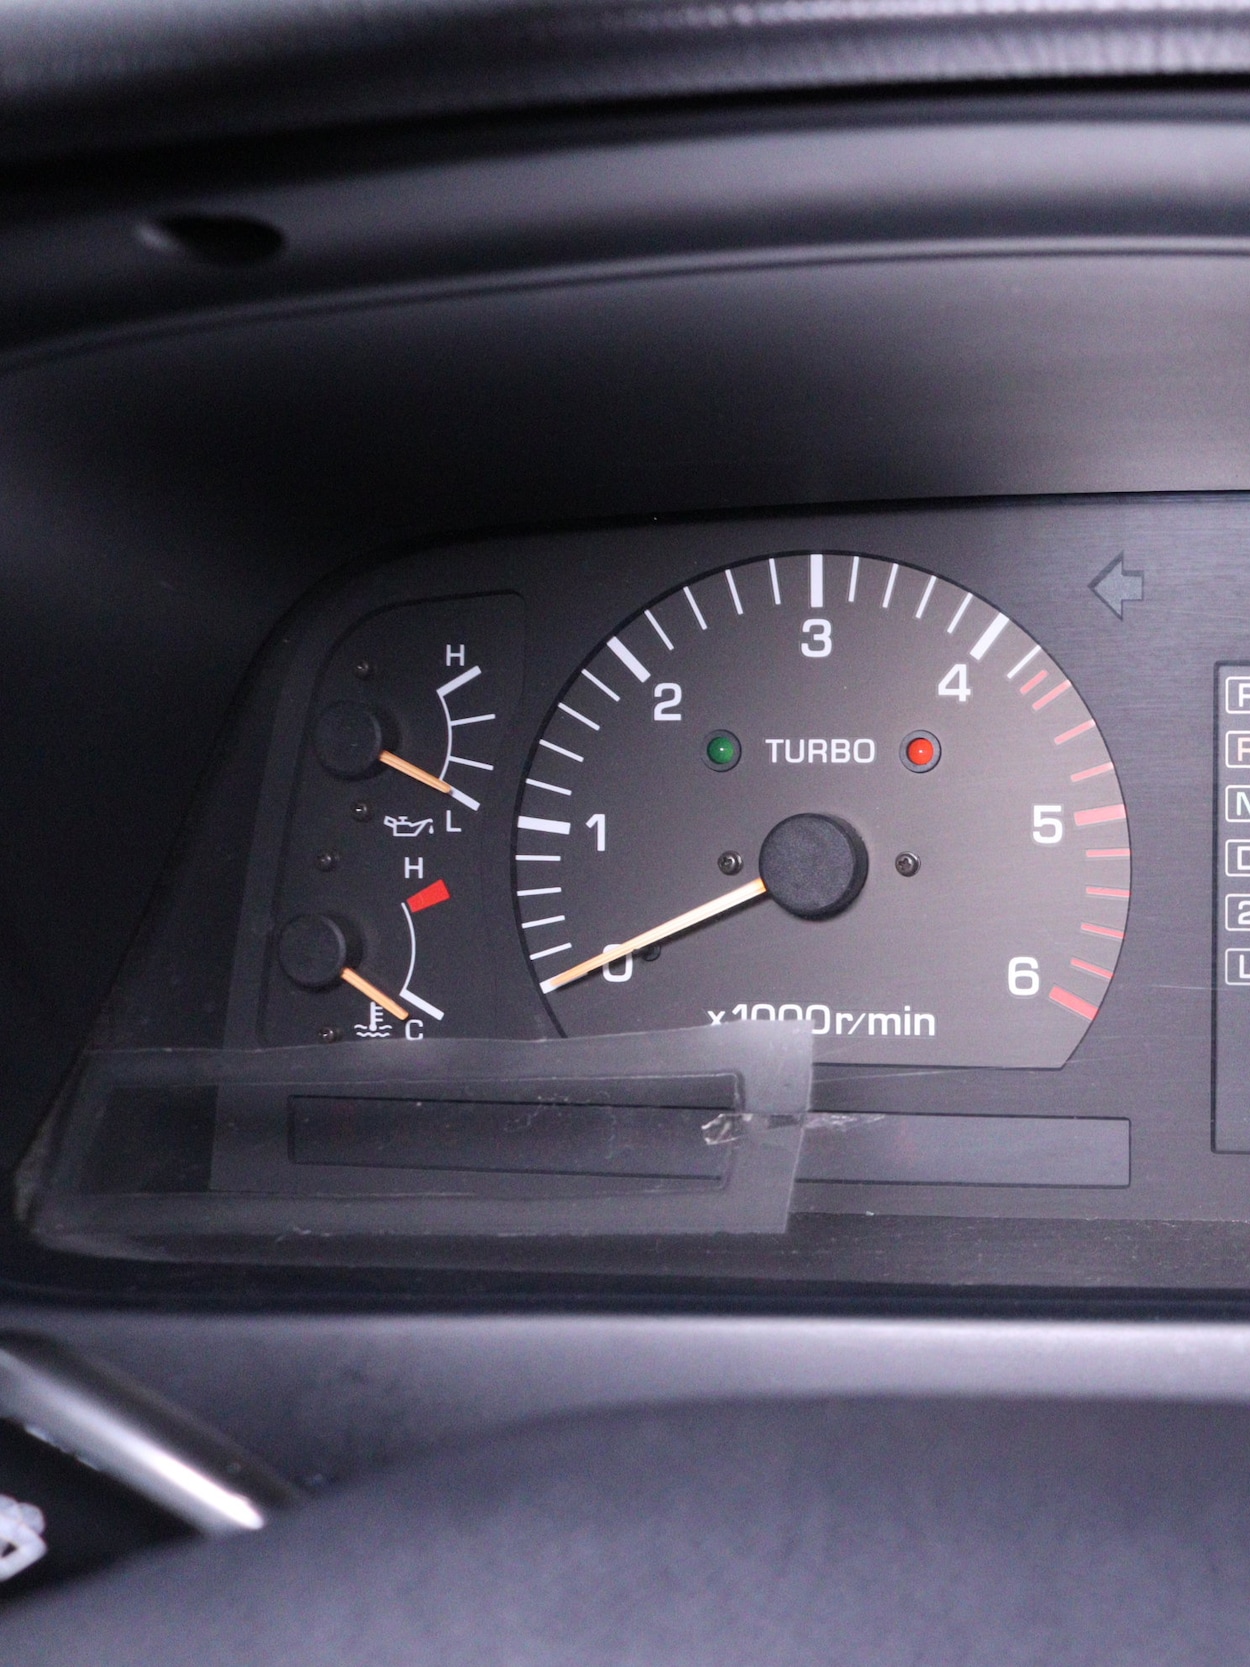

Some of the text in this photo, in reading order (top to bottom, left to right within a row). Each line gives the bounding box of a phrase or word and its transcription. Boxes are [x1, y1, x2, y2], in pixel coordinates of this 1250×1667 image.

[446, 644, 465, 667] H
[801, 618, 833, 658] 3
[653, 682, 682, 721] 2
[937, 663, 972, 703] 4
[765, 738, 876, 764] TURBO
[446, 809, 462, 833] L
[585, 813, 606, 852] 1
[1032, 804, 1063, 845] 5
[404, 856, 424, 879] H
[602, 943, 633, 983] 0
[1007, 956, 1040, 996] 6
[405, 1019, 424, 1042] C
